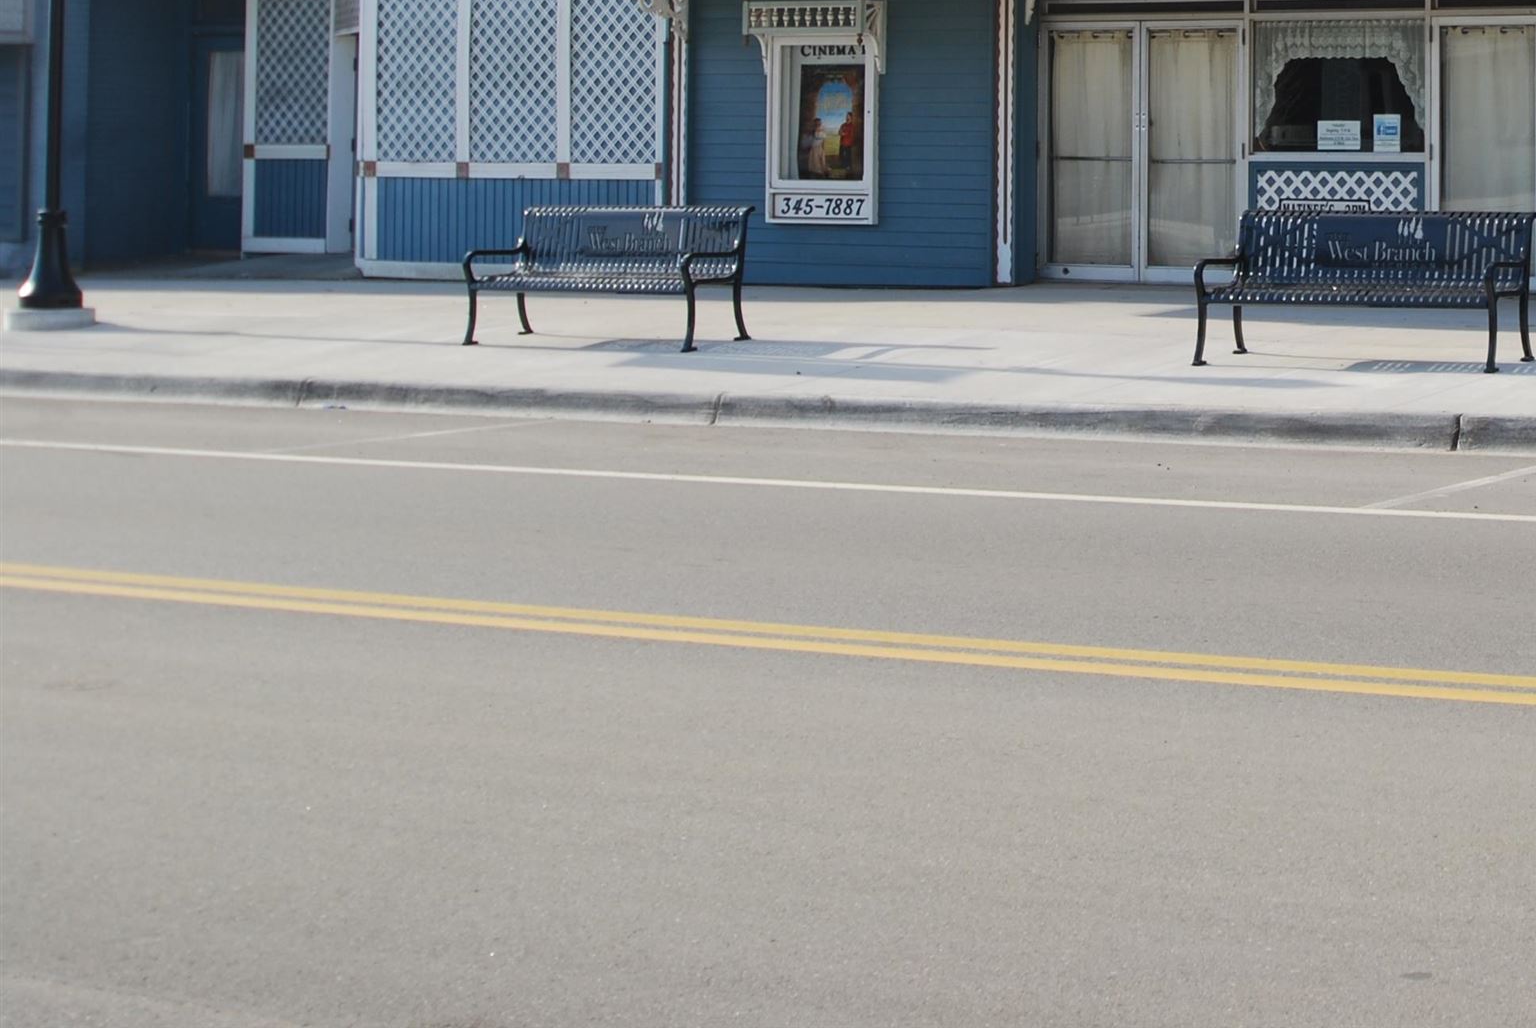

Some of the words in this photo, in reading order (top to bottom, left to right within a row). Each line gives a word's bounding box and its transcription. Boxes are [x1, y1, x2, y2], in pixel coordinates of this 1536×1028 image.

[781, 197, 866, 215] 345-7887
[1327, 240, 1368, 261] West
[1374, 240, 1436, 261] Branch
